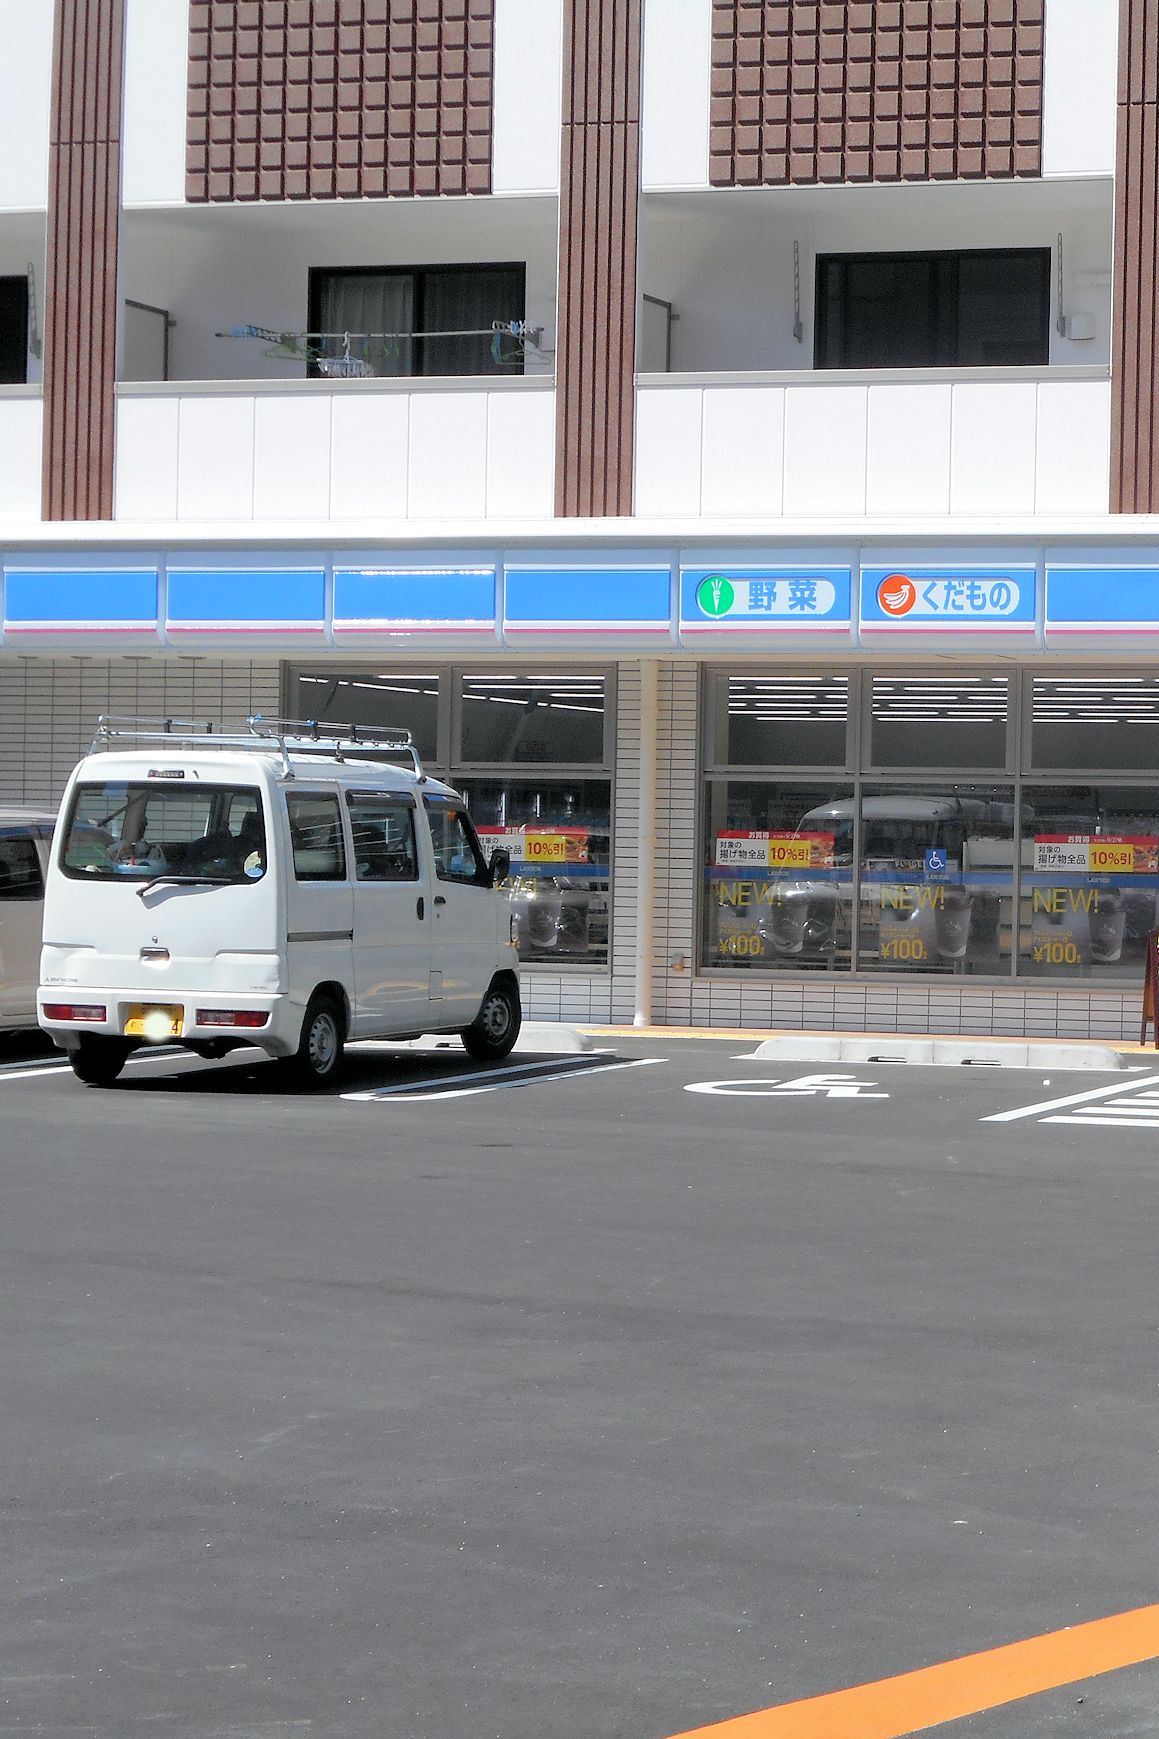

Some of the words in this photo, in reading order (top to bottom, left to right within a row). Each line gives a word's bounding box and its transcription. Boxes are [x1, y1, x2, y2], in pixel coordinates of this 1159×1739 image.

[747, 579, 818, 611] 野菜
[922, 580, 1011, 611] くだもの
[527, 842, 564, 855] 10%引
[770, 847, 810, 861] 10%引
[1091, 851, 1131, 865] 10%引
[881, 885, 945, 911] NEW!
[1034, 888, 1100, 913] NEW!
[881, 939, 924, 960] ¥100
[1033, 942, 1077, 964] ¥100
